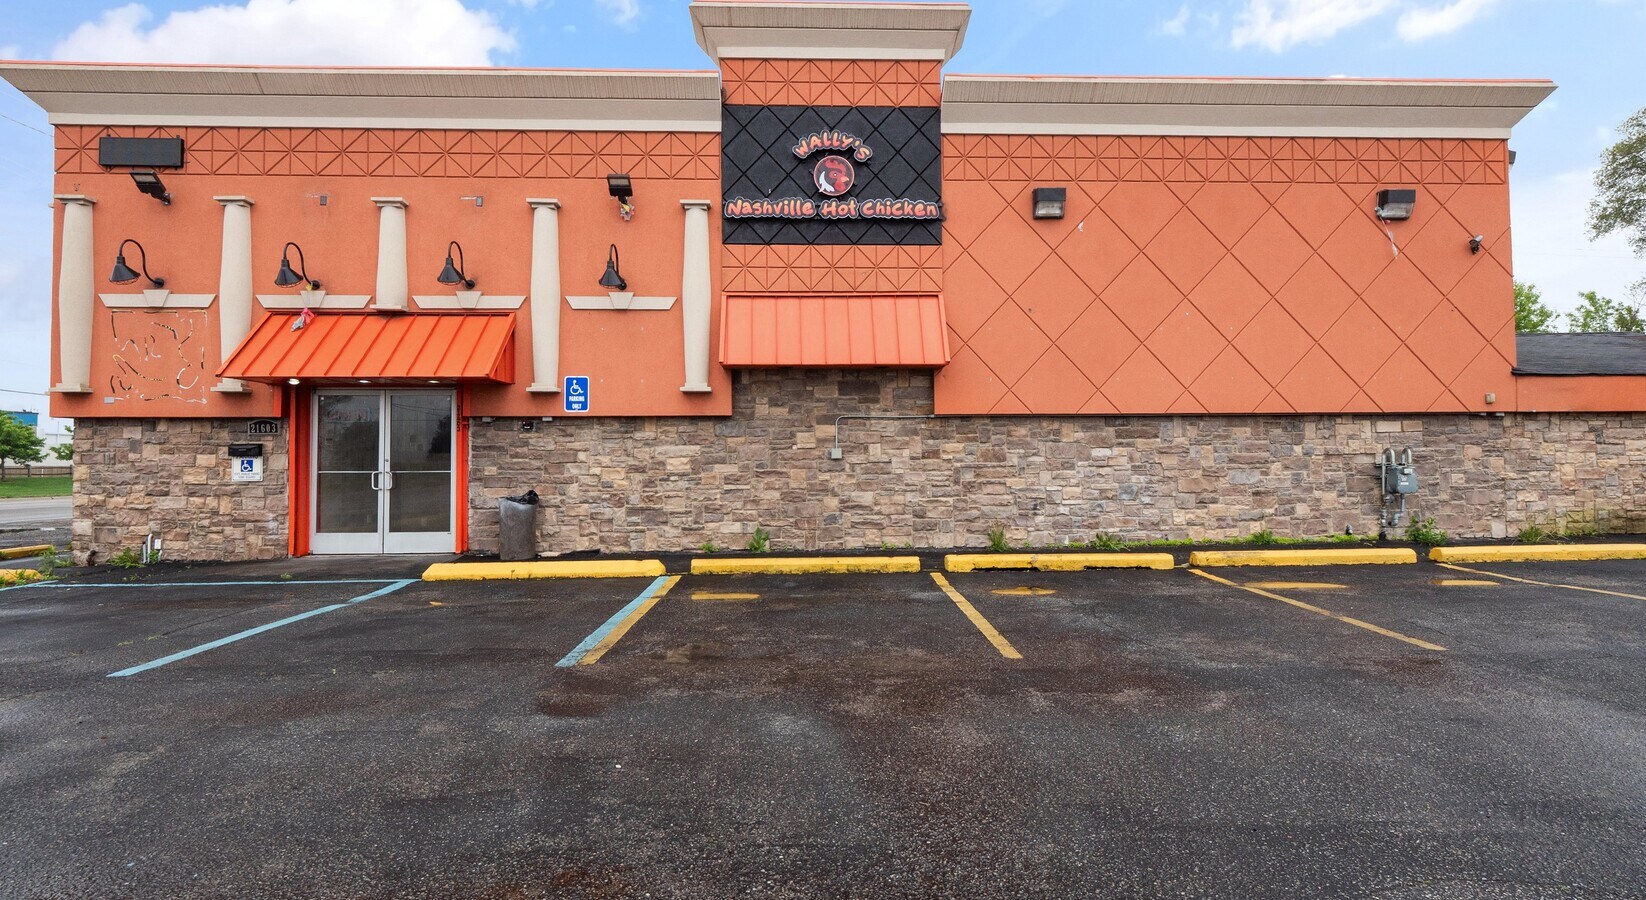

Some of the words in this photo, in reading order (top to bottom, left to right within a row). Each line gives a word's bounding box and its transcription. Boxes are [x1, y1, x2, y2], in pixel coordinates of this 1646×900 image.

[792, 129, 872, 161] WALLY'S
[725, 196, 815, 219] Nashville
[820, 197, 859, 219] Hot
[860, 198, 939, 219] Chicken
[250, 423, 276, 433] 21603
